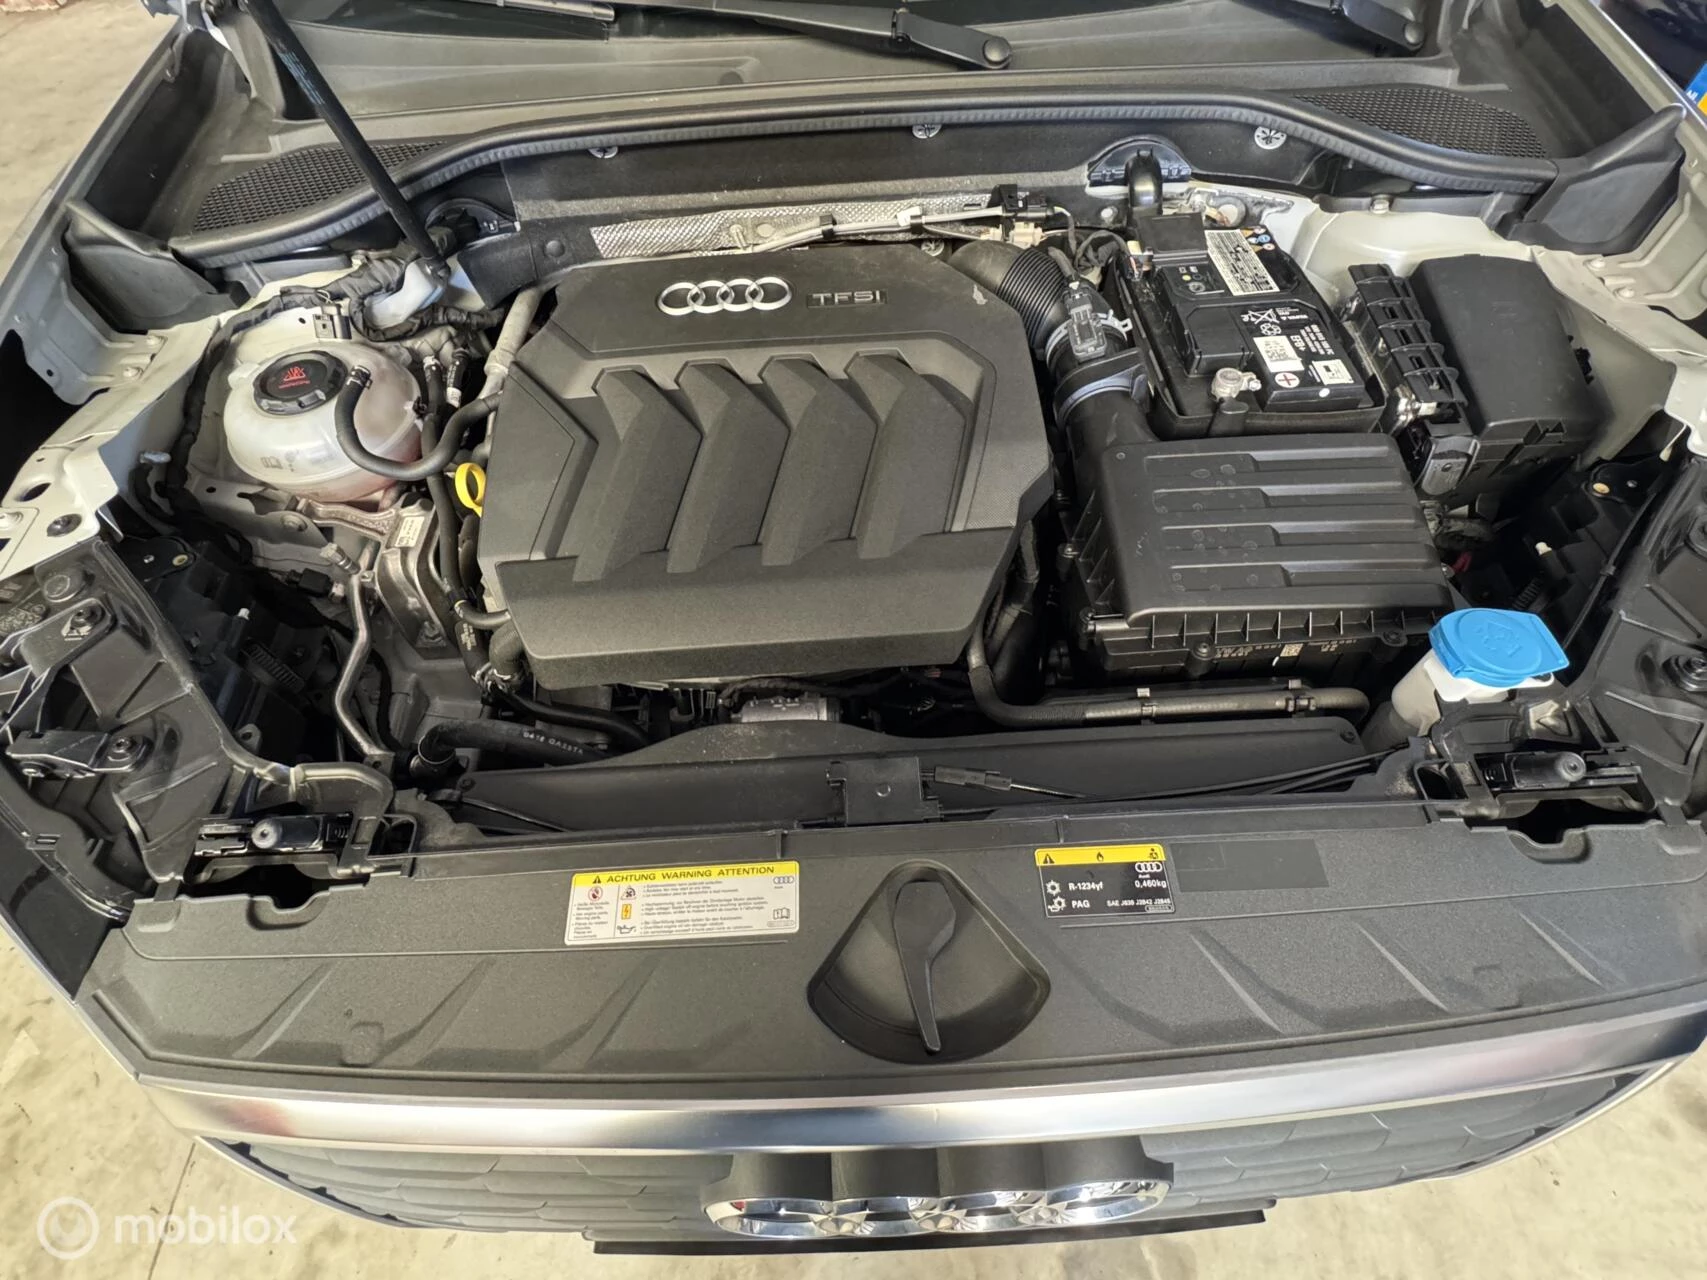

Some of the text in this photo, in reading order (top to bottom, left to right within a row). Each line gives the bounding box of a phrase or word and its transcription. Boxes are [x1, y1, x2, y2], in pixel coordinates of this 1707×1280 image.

[813, 290, 883, 305] TFSI
[607, 865, 775, 883] ACHTUNG WARNING ATTENTION
[1068, 881, 1104, 891] R-1234yf
[1071, 899, 1090, 908] PAG
